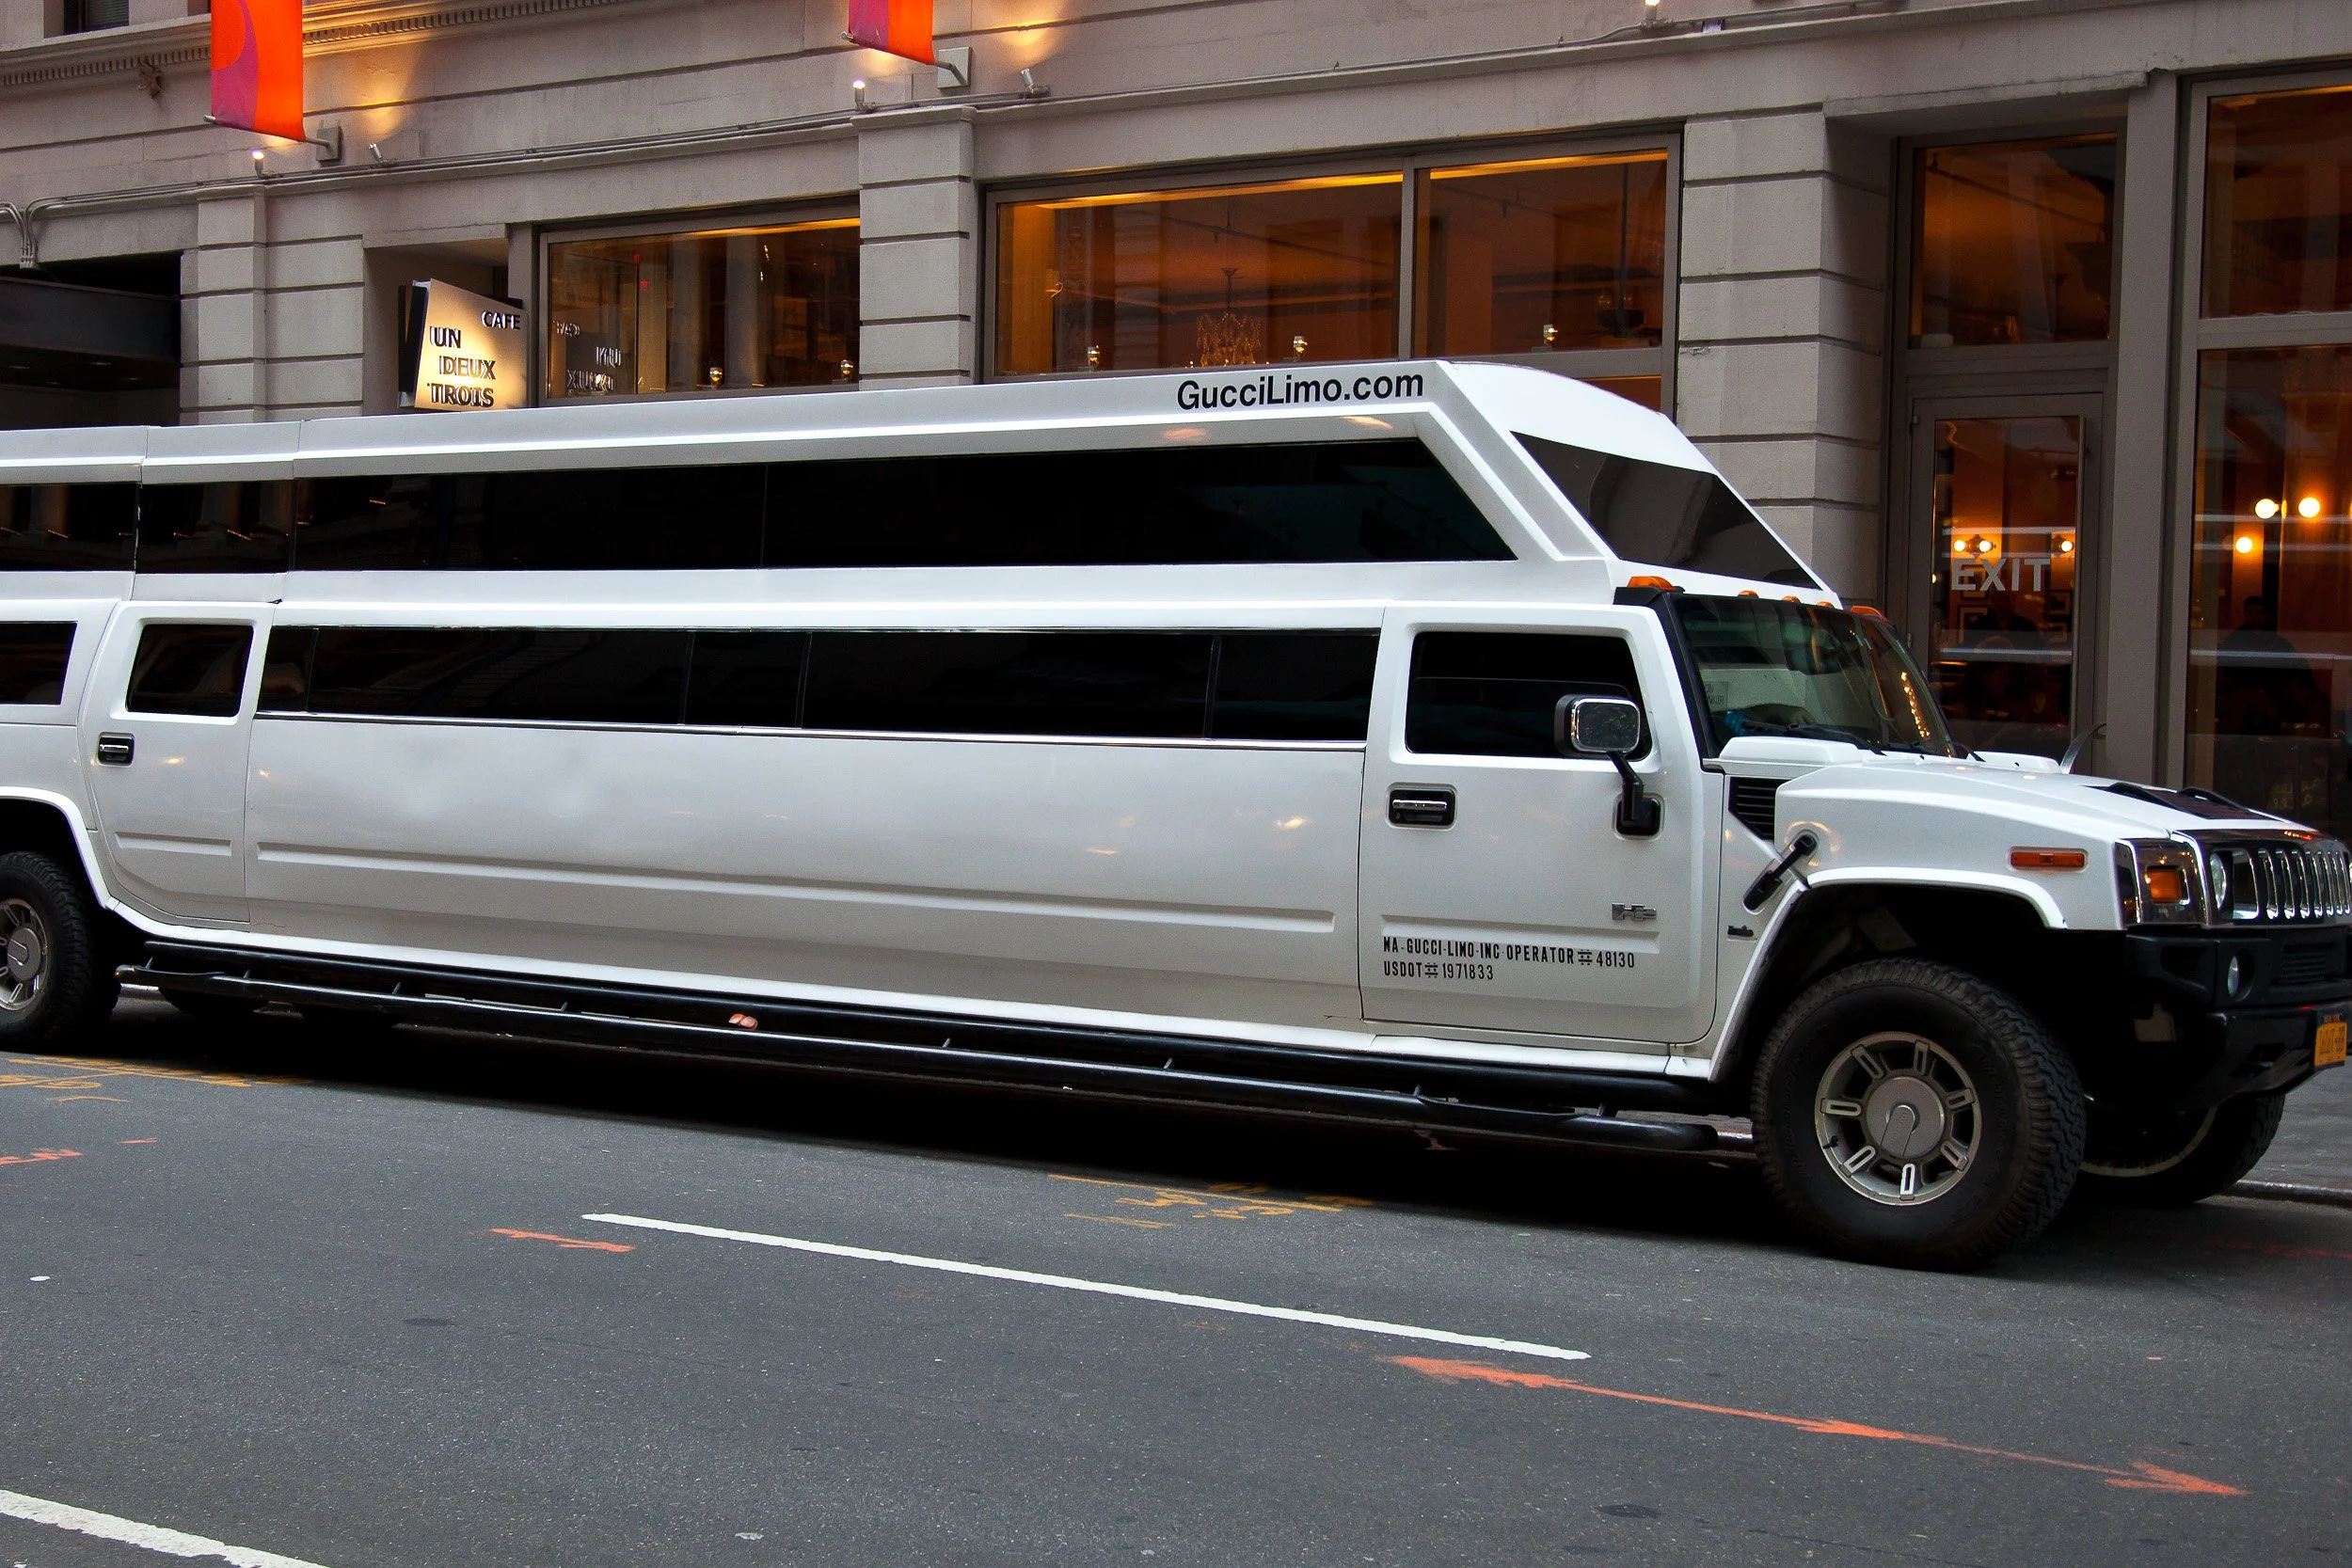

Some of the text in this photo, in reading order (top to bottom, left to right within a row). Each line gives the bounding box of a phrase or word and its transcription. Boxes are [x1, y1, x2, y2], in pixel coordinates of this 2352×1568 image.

[481, 310, 520, 330] CAFE
[430, 325, 461, 348] UN
[439, 356, 496, 380] DEUX
[427, 382, 495, 407] TROIS
[1177, 373, 1423, 410] GucciLimo.com
[1951, 558, 2051, 592] EXIT
